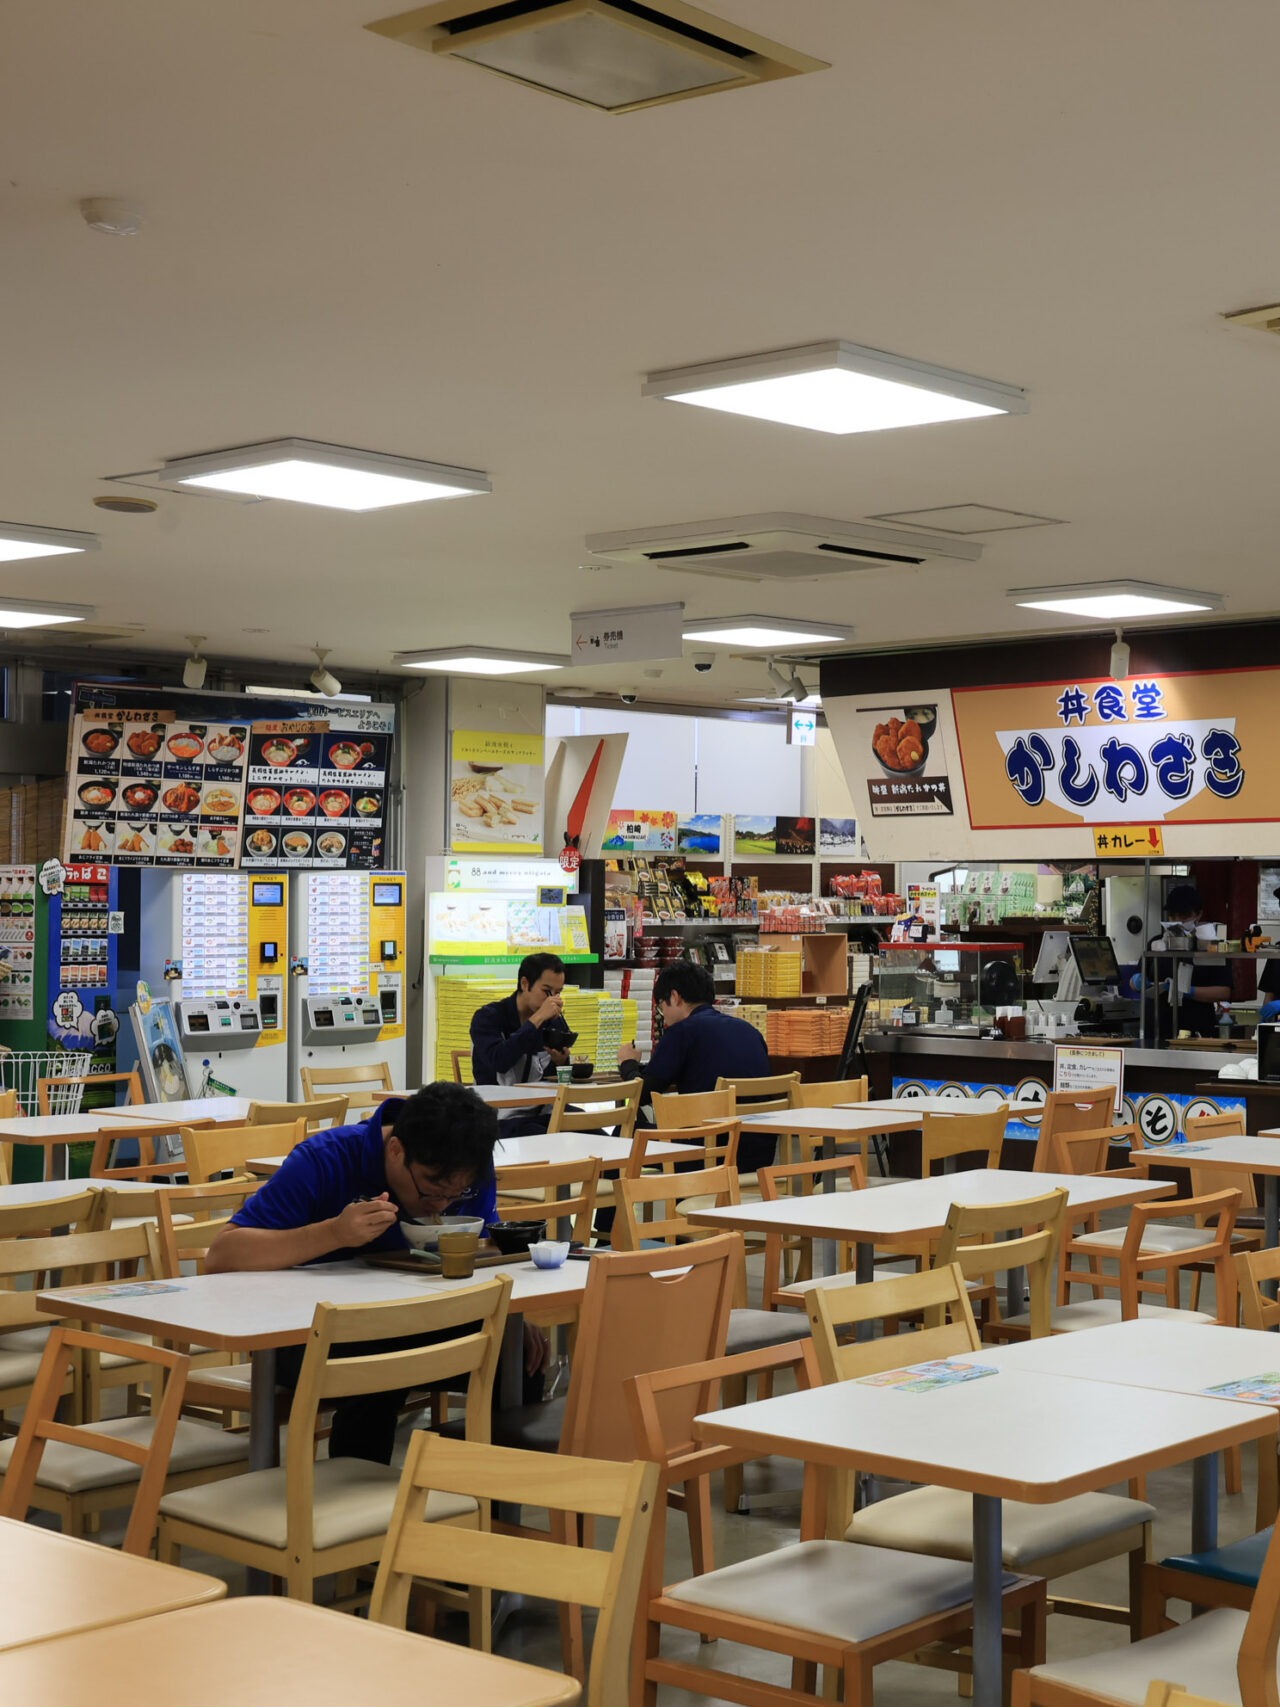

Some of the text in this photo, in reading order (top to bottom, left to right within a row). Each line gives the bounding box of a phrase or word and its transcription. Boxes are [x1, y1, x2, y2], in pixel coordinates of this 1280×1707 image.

[1057, 681, 1168, 725] 丼食堂
[1003, 728, 1247, 807] かしわざき
[626, 823, 641, 834] 柏崎
[1097, 834, 1145, 849] 丼カレー
[560, 856, 580, 869] 限定
